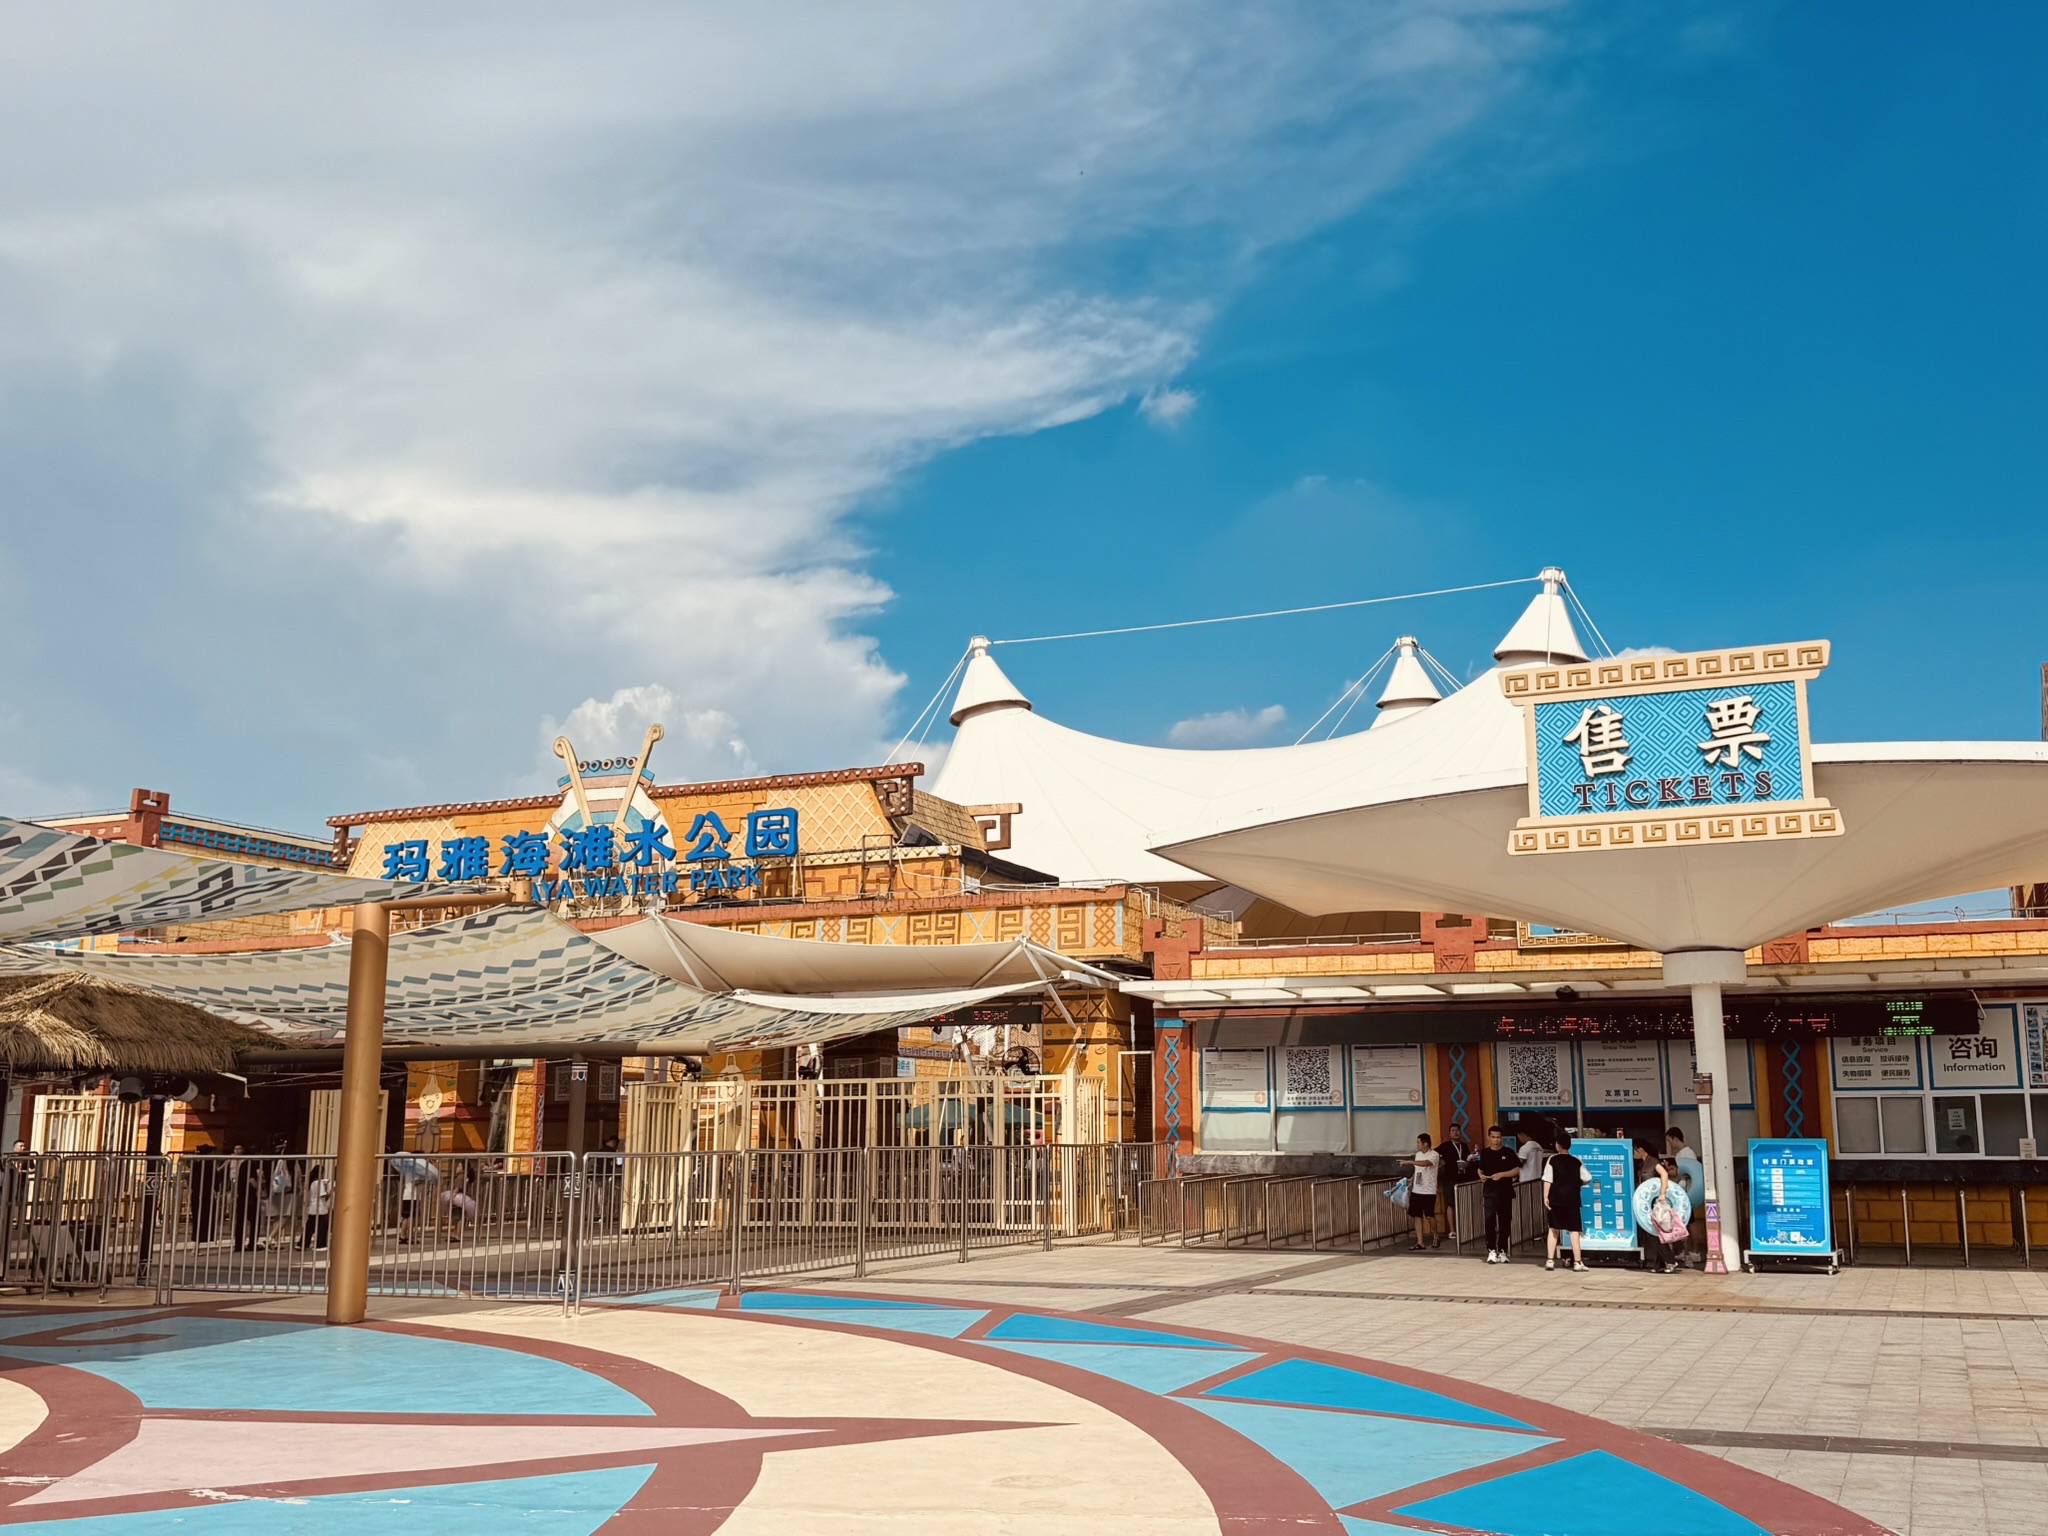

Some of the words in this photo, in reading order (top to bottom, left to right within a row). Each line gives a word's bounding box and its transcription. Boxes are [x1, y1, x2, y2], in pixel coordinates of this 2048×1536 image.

[1563, 694, 1771, 778] 售票
[1573, 770, 1773, 808] TICKETS
[381, 807, 798, 882] 玛雅海滩水公园
[584, 872, 679, 898] WATER
[690, 863, 762, 891] PARK
[1948, 1036, 1998, 1060] 咨询
[1841, 1055, 1871, 1063] 信息咨询
[1880, 1054, 1910, 1062] 投诉接待
[1943, 1062, 2006, 1072] Information
[1842, 1069, 1872, 1077] 失物招领
[1881, 1069, 1911, 1077] 便民服务
[1604, 1089, 1640, 1097] 发票窗口
